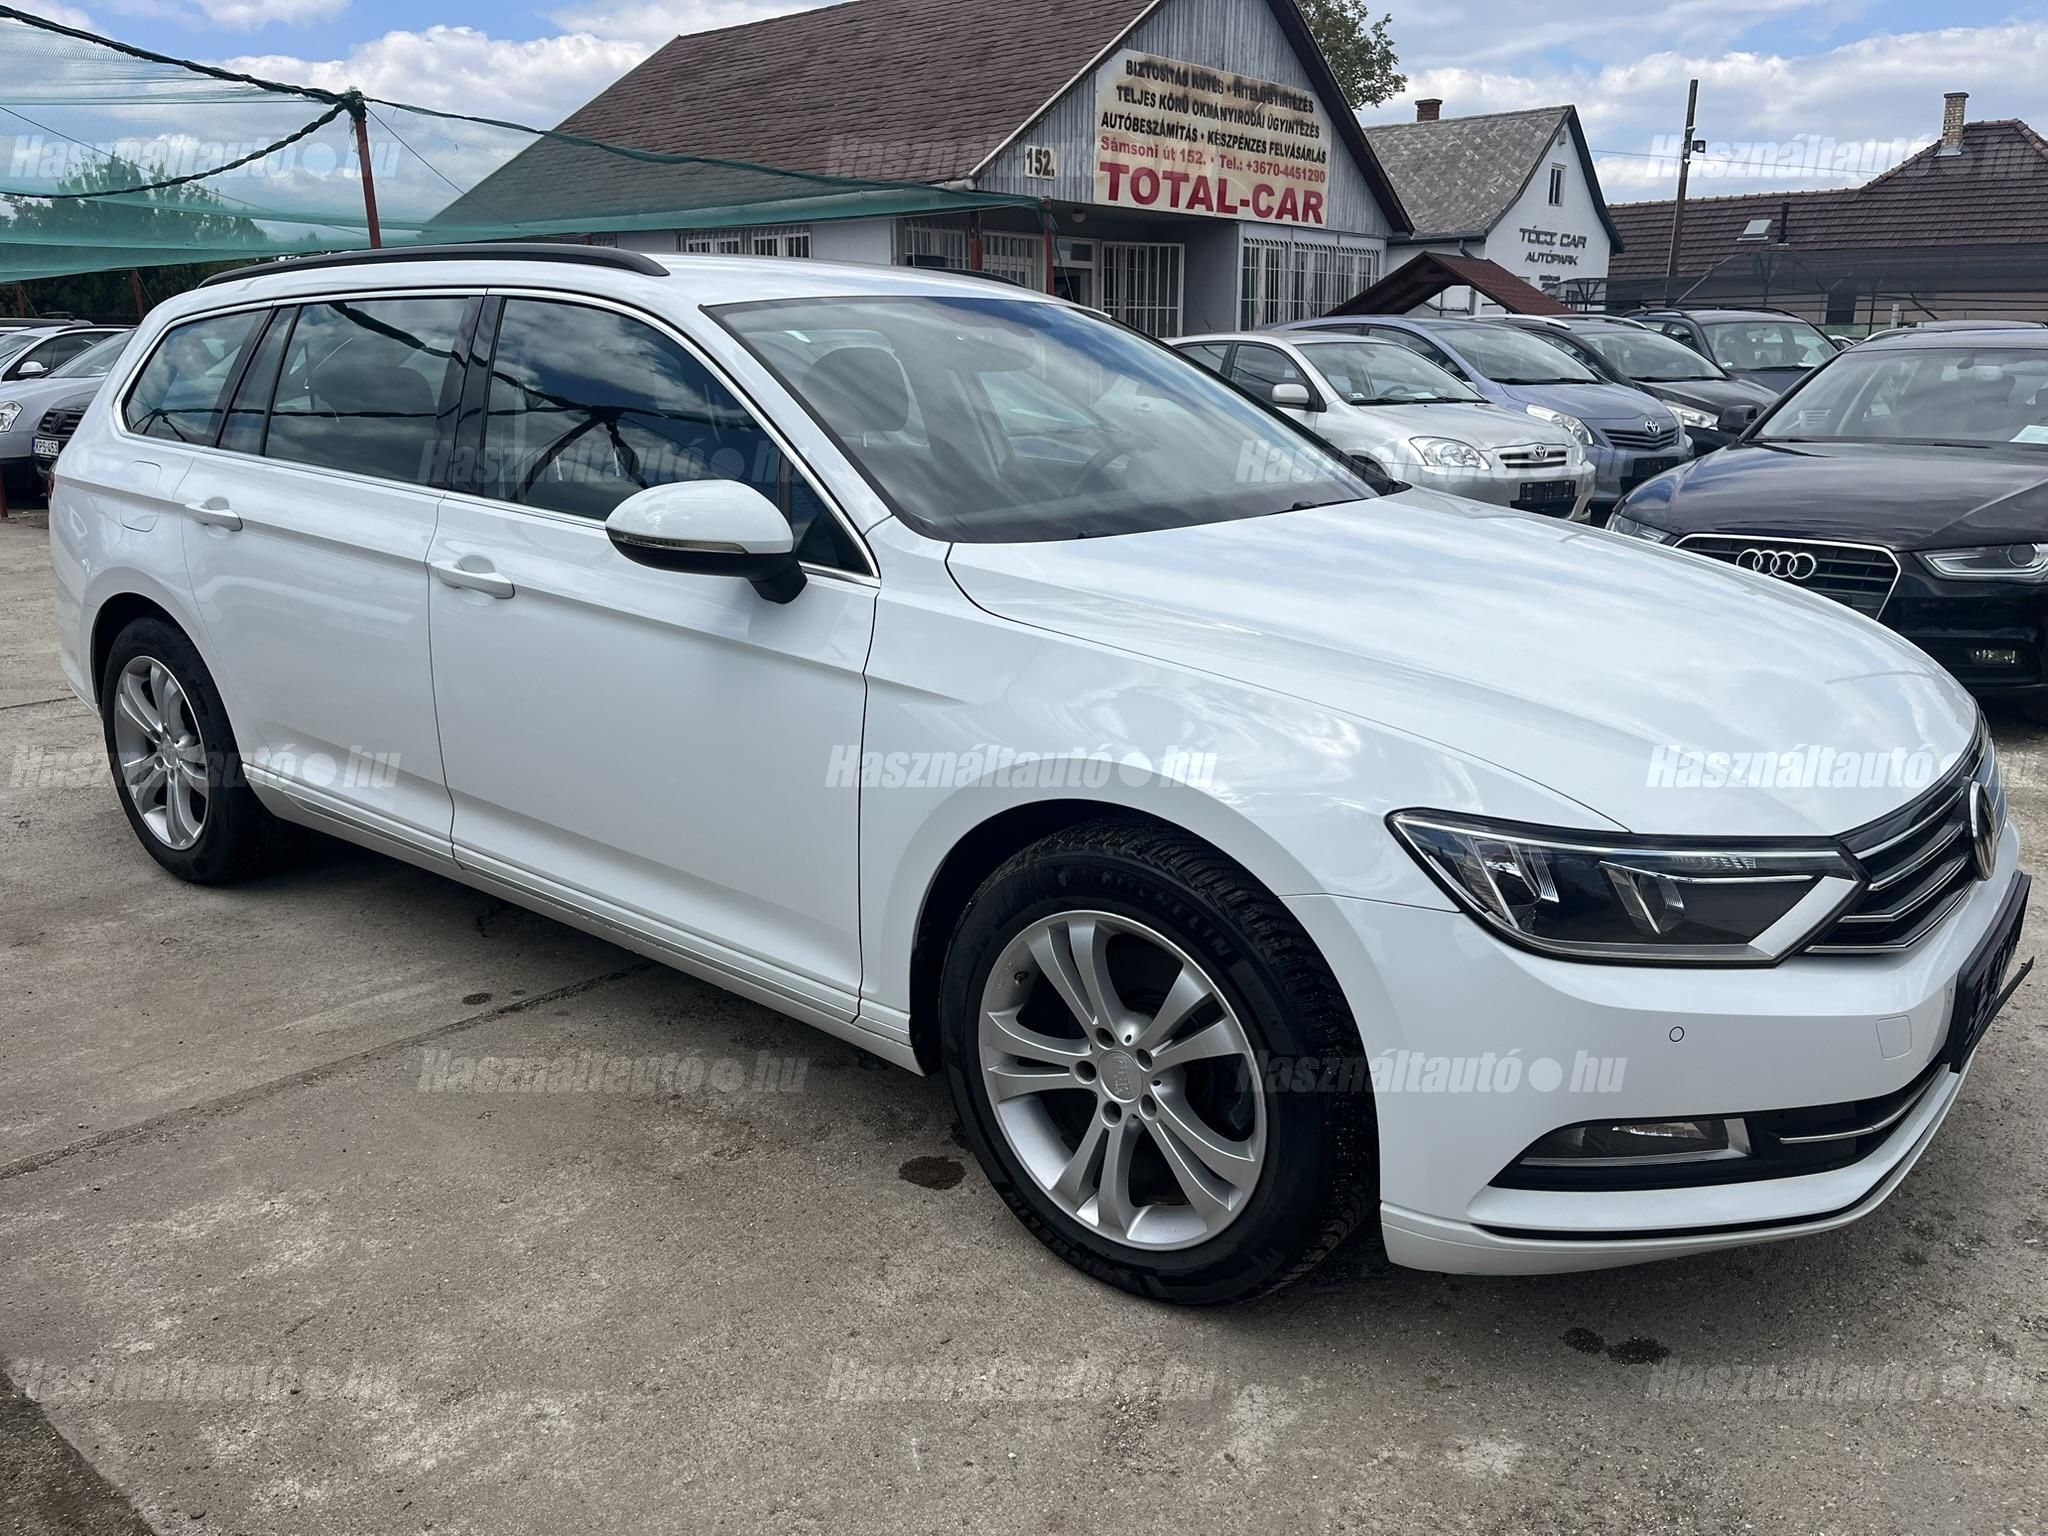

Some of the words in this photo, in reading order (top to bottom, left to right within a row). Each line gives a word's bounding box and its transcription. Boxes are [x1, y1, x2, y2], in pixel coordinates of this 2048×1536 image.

[1117, 85, 1156, 108] TELJES
[1101, 111, 1198, 142] AUTÓBESZÁMÍTÁS
[1207, 129, 1267, 154] KÉSZPÉNZES
[1269, 142, 1327, 164] FELVÁSÁRLÁS
[1026, 147, 1055, 177] 152.
[1101, 135, 1159, 158] Sámsoni
[1163, 146, 1176, 161] út
[1180, 148, 1206, 165] 152.
[1220, 154, 1243, 171] Tel.:
[1100, 161, 1324, 224] TOTAL-CAR
[1560, 233, 1587, 248] CAR
[1525, 250, 1579, 266] AUTÓPARK
